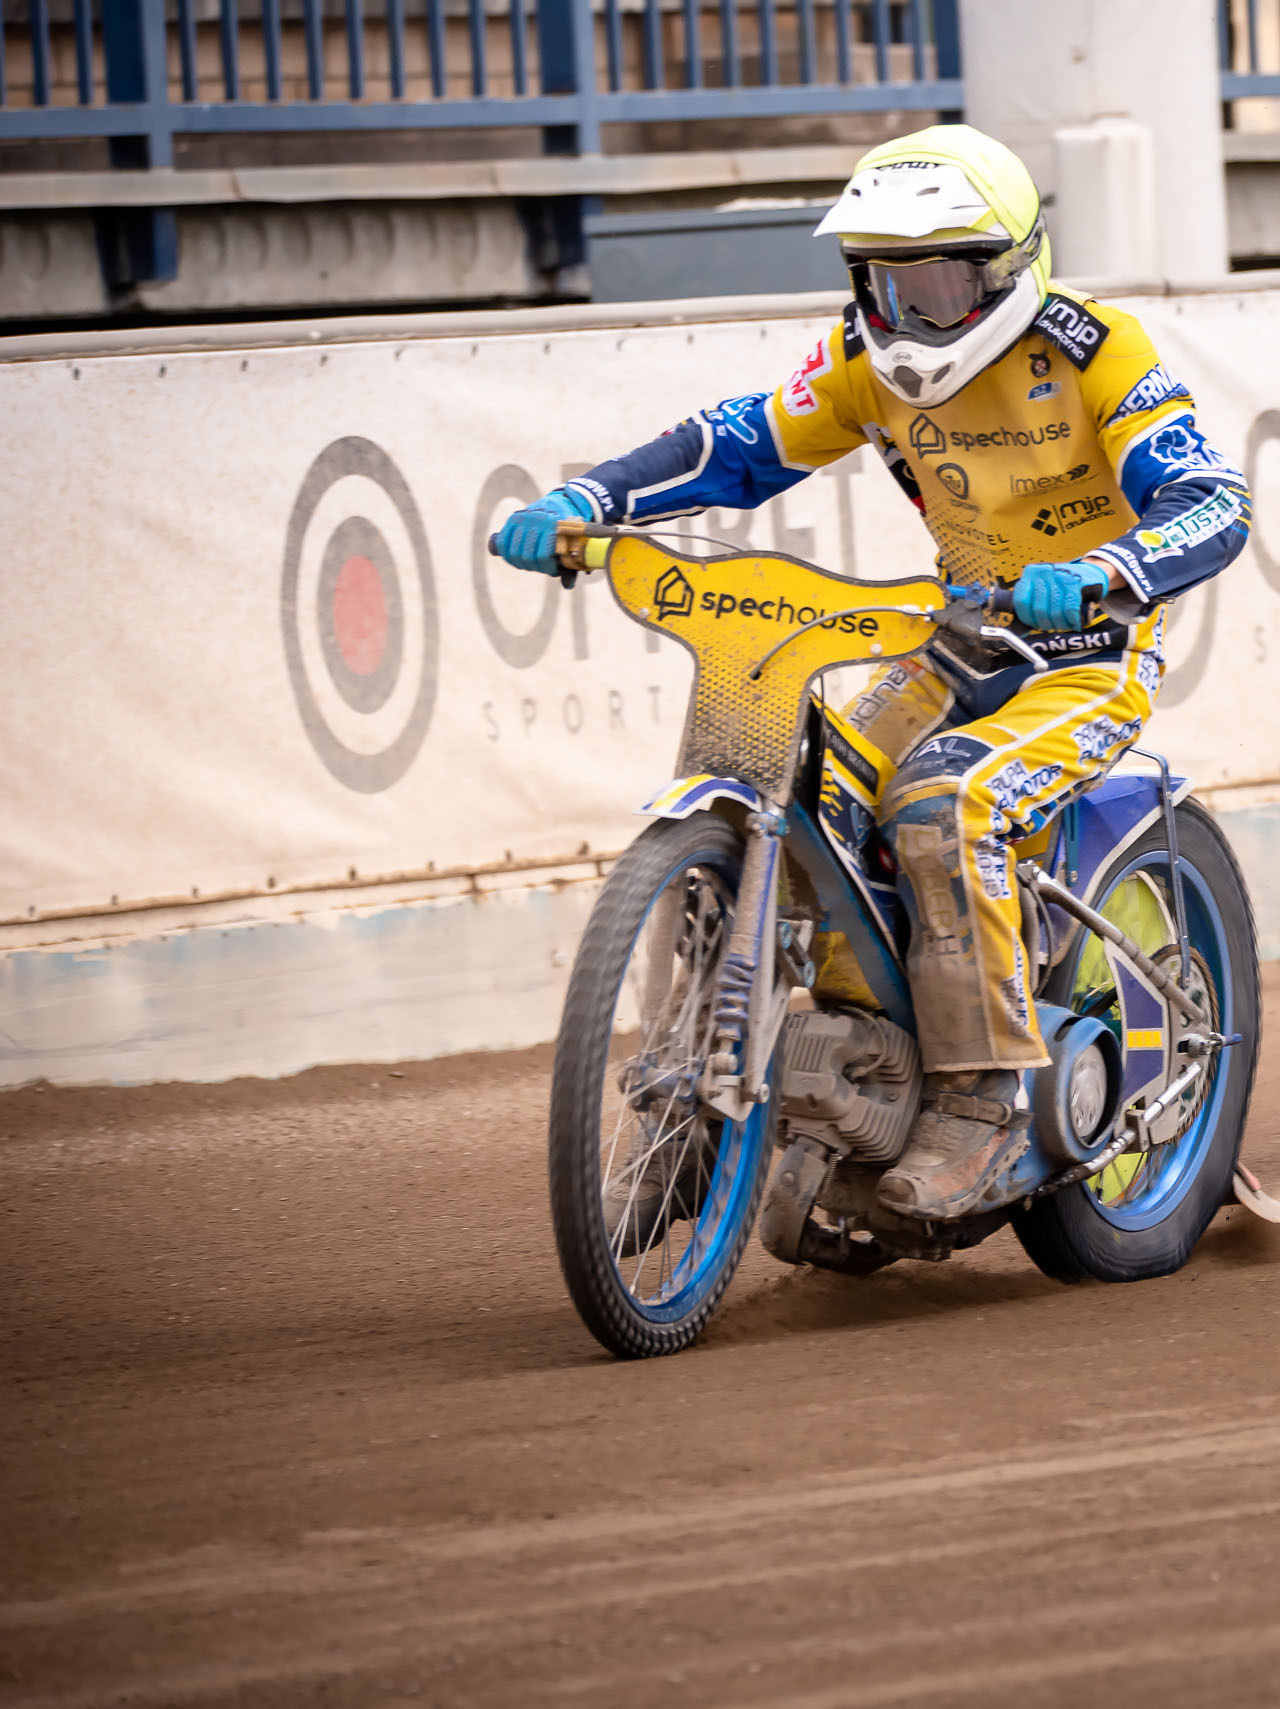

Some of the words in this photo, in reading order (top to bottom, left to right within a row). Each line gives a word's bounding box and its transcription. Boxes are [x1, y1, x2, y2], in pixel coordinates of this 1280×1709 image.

[1048, 302, 1099, 345] mjp
[951, 421, 1071, 451] spechouse
[1059, 495, 1110, 519] mjp
[700, 591, 879, 637] spechouse
